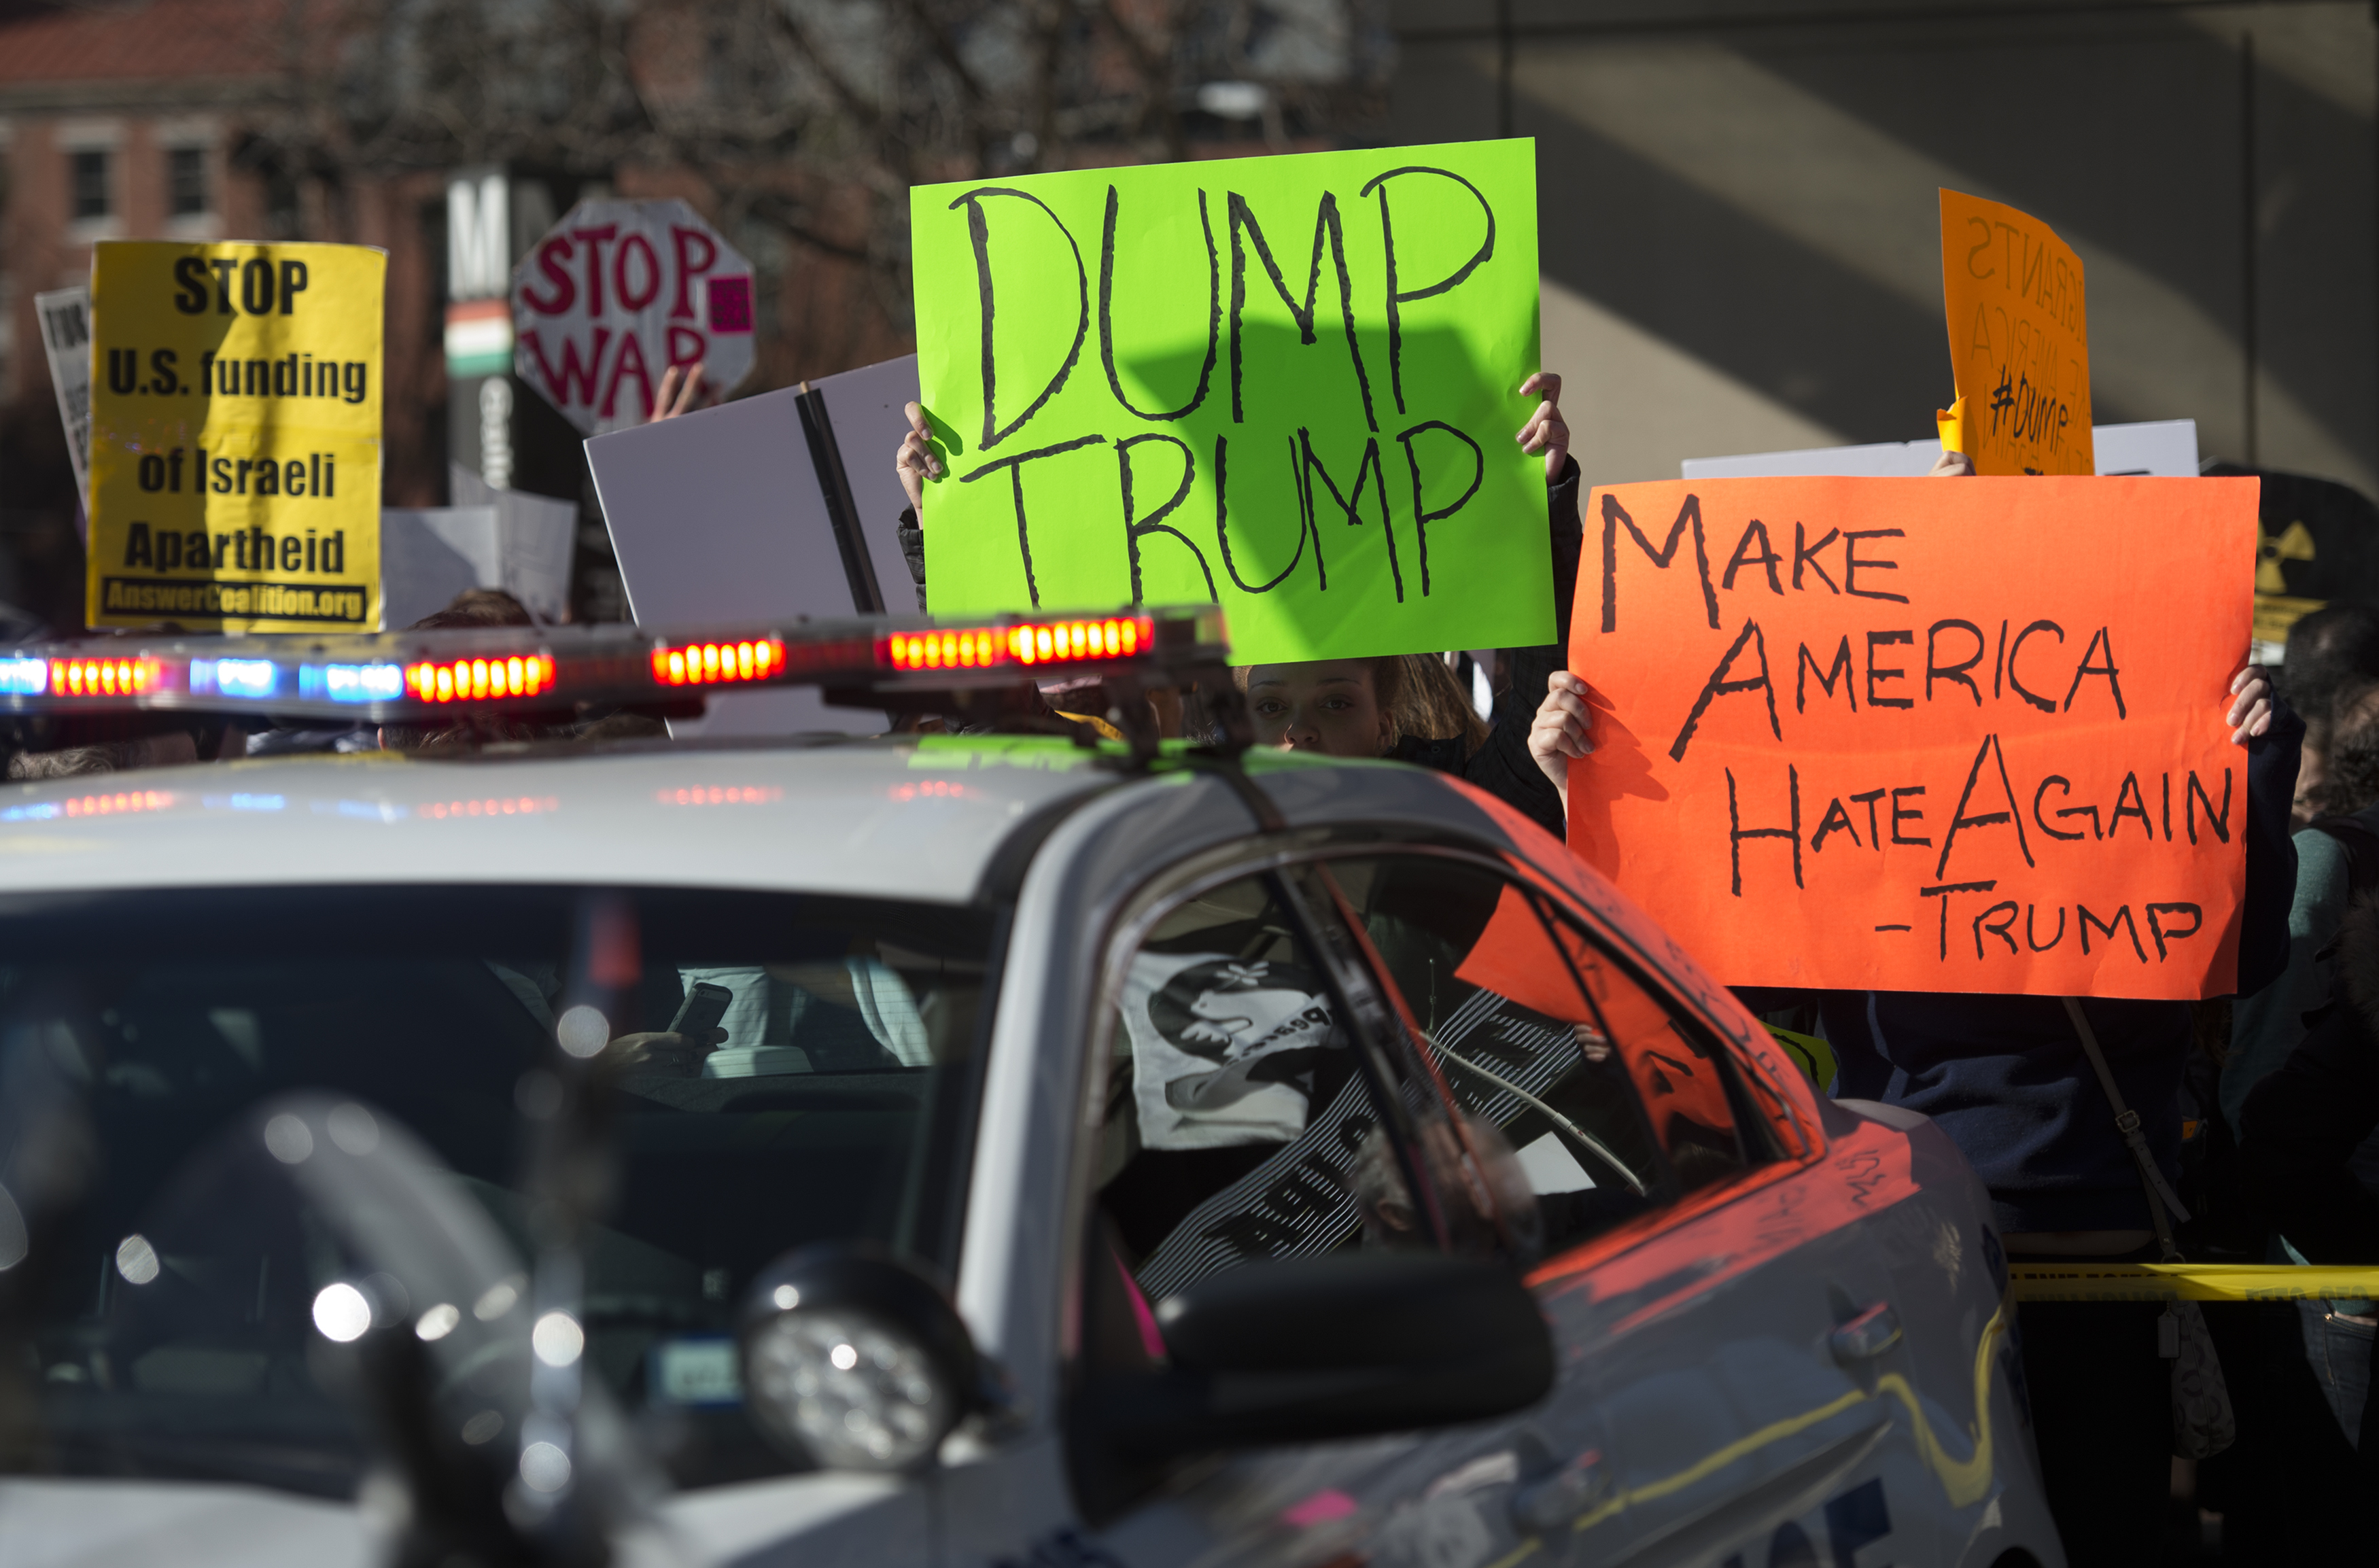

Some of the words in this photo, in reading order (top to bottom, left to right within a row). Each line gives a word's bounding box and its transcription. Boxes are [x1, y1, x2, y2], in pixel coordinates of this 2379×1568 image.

[173, 254, 309, 318] STOP
[520, 222, 718, 319] STOP
[949, 167, 1495, 451] DUMP
[107, 347, 189, 396] U.S.
[198, 349, 366, 404] funding
[138, 449, 186, 494] of
[194, 447, 335, 498] Israeli
[960, 420, 1484, 612] TRUMP
[124, 521, 345, 574] Apartheid
[1602, 495, 1909, 633] MAKE
[1669, 619, 2125, 762] AMERICA
[1726, 764, 1932, 897] HATE
[1937, 734, 2232, 881] AGAIN
